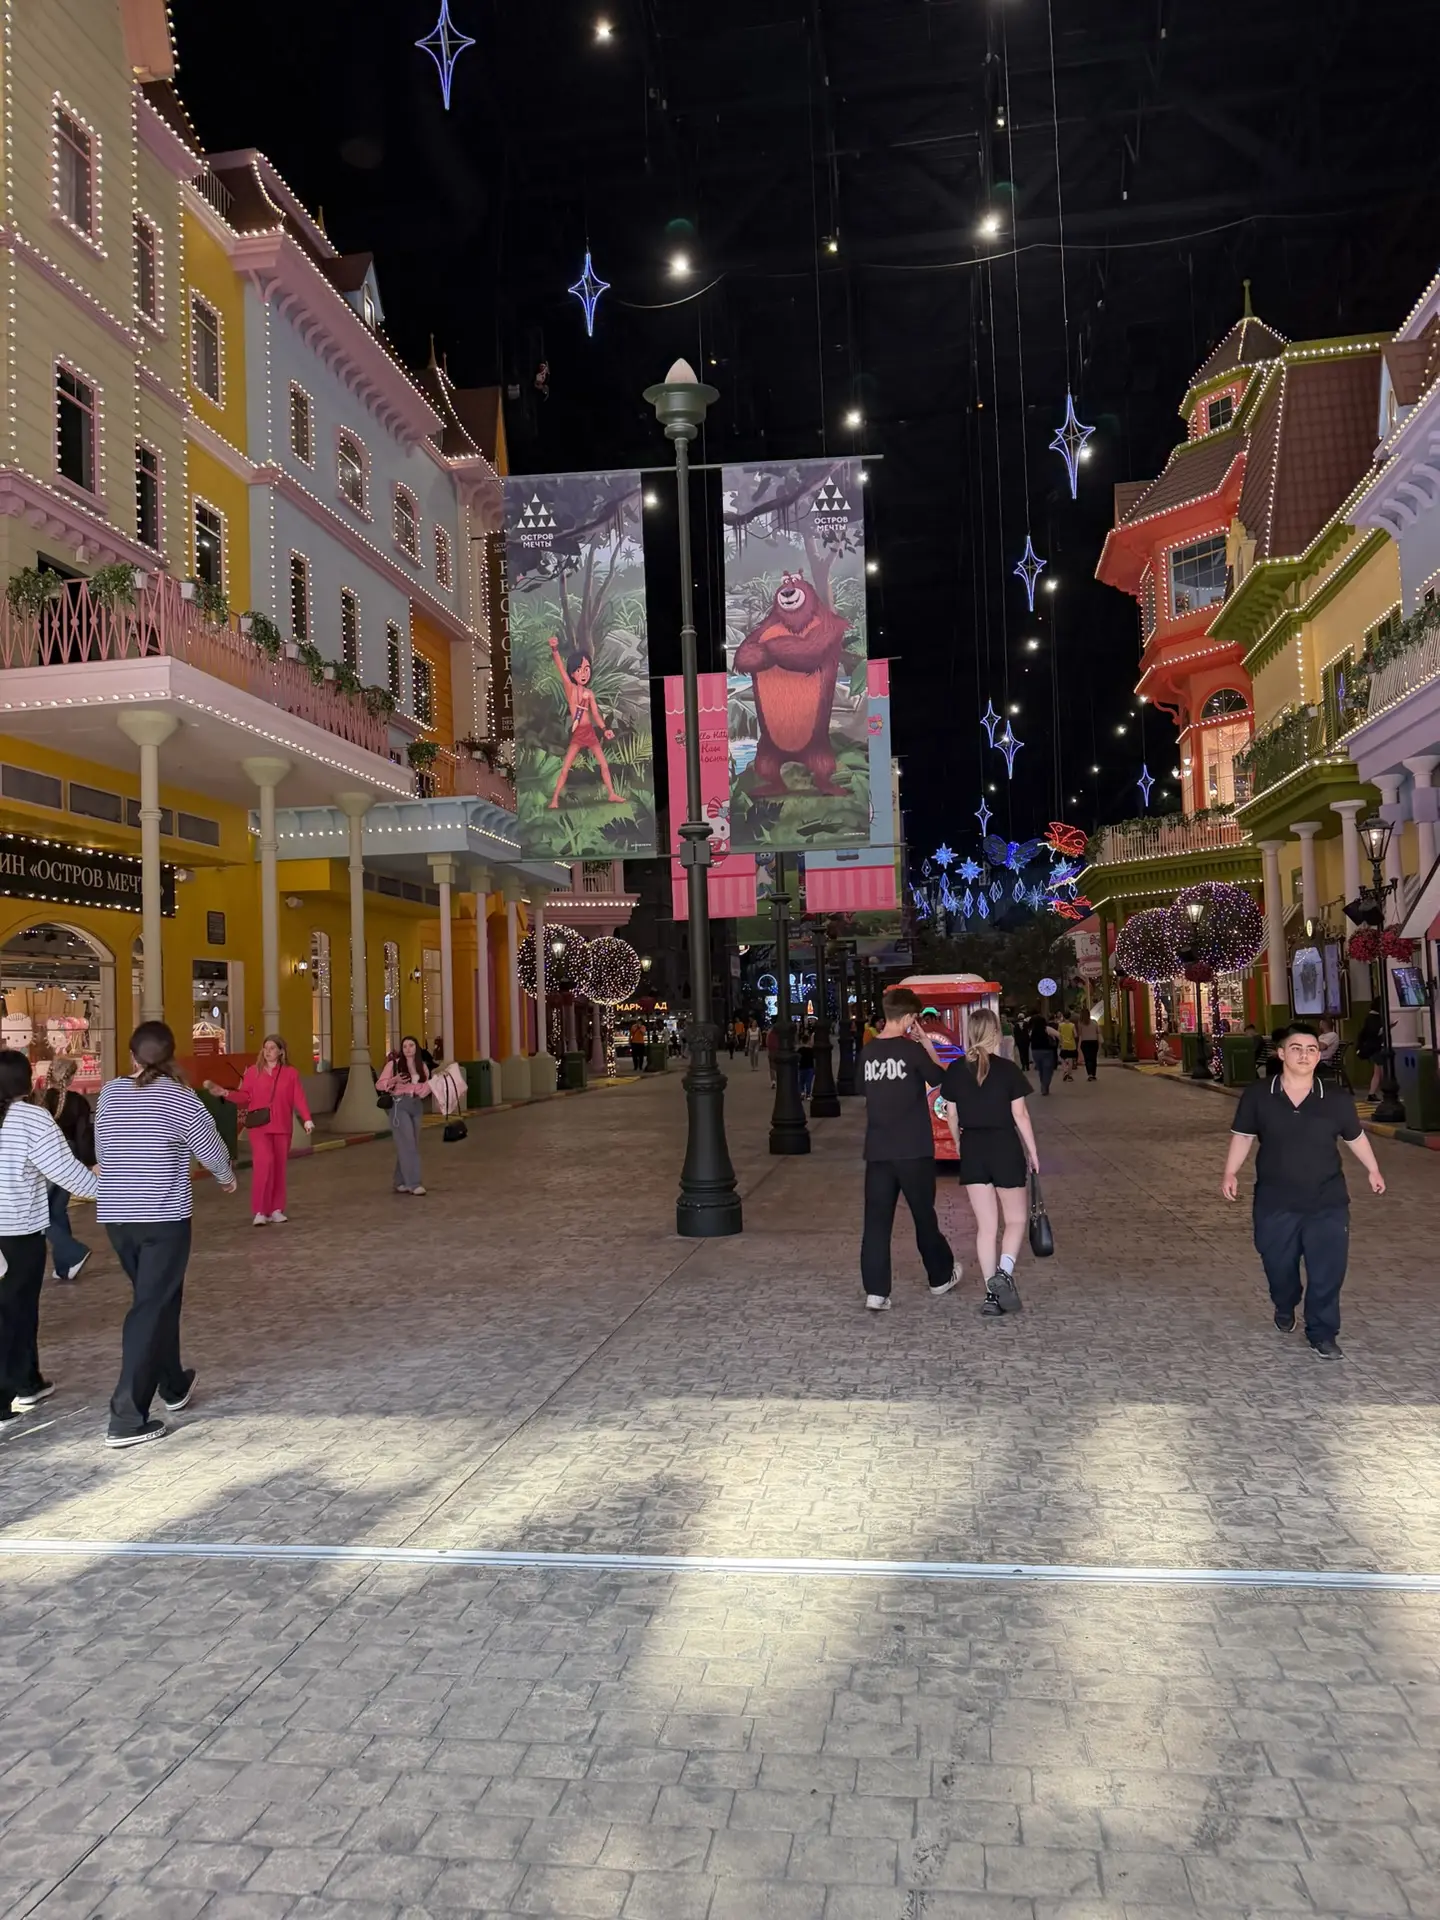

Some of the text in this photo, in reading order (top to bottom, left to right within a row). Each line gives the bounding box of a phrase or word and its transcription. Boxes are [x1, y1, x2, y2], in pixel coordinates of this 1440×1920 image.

[814, 516, 849, 525] ОСТРОВ
[520, 533, 554, 541] ОСТРОВ
[29, 859, 104, 888] «ОСТРОВ
